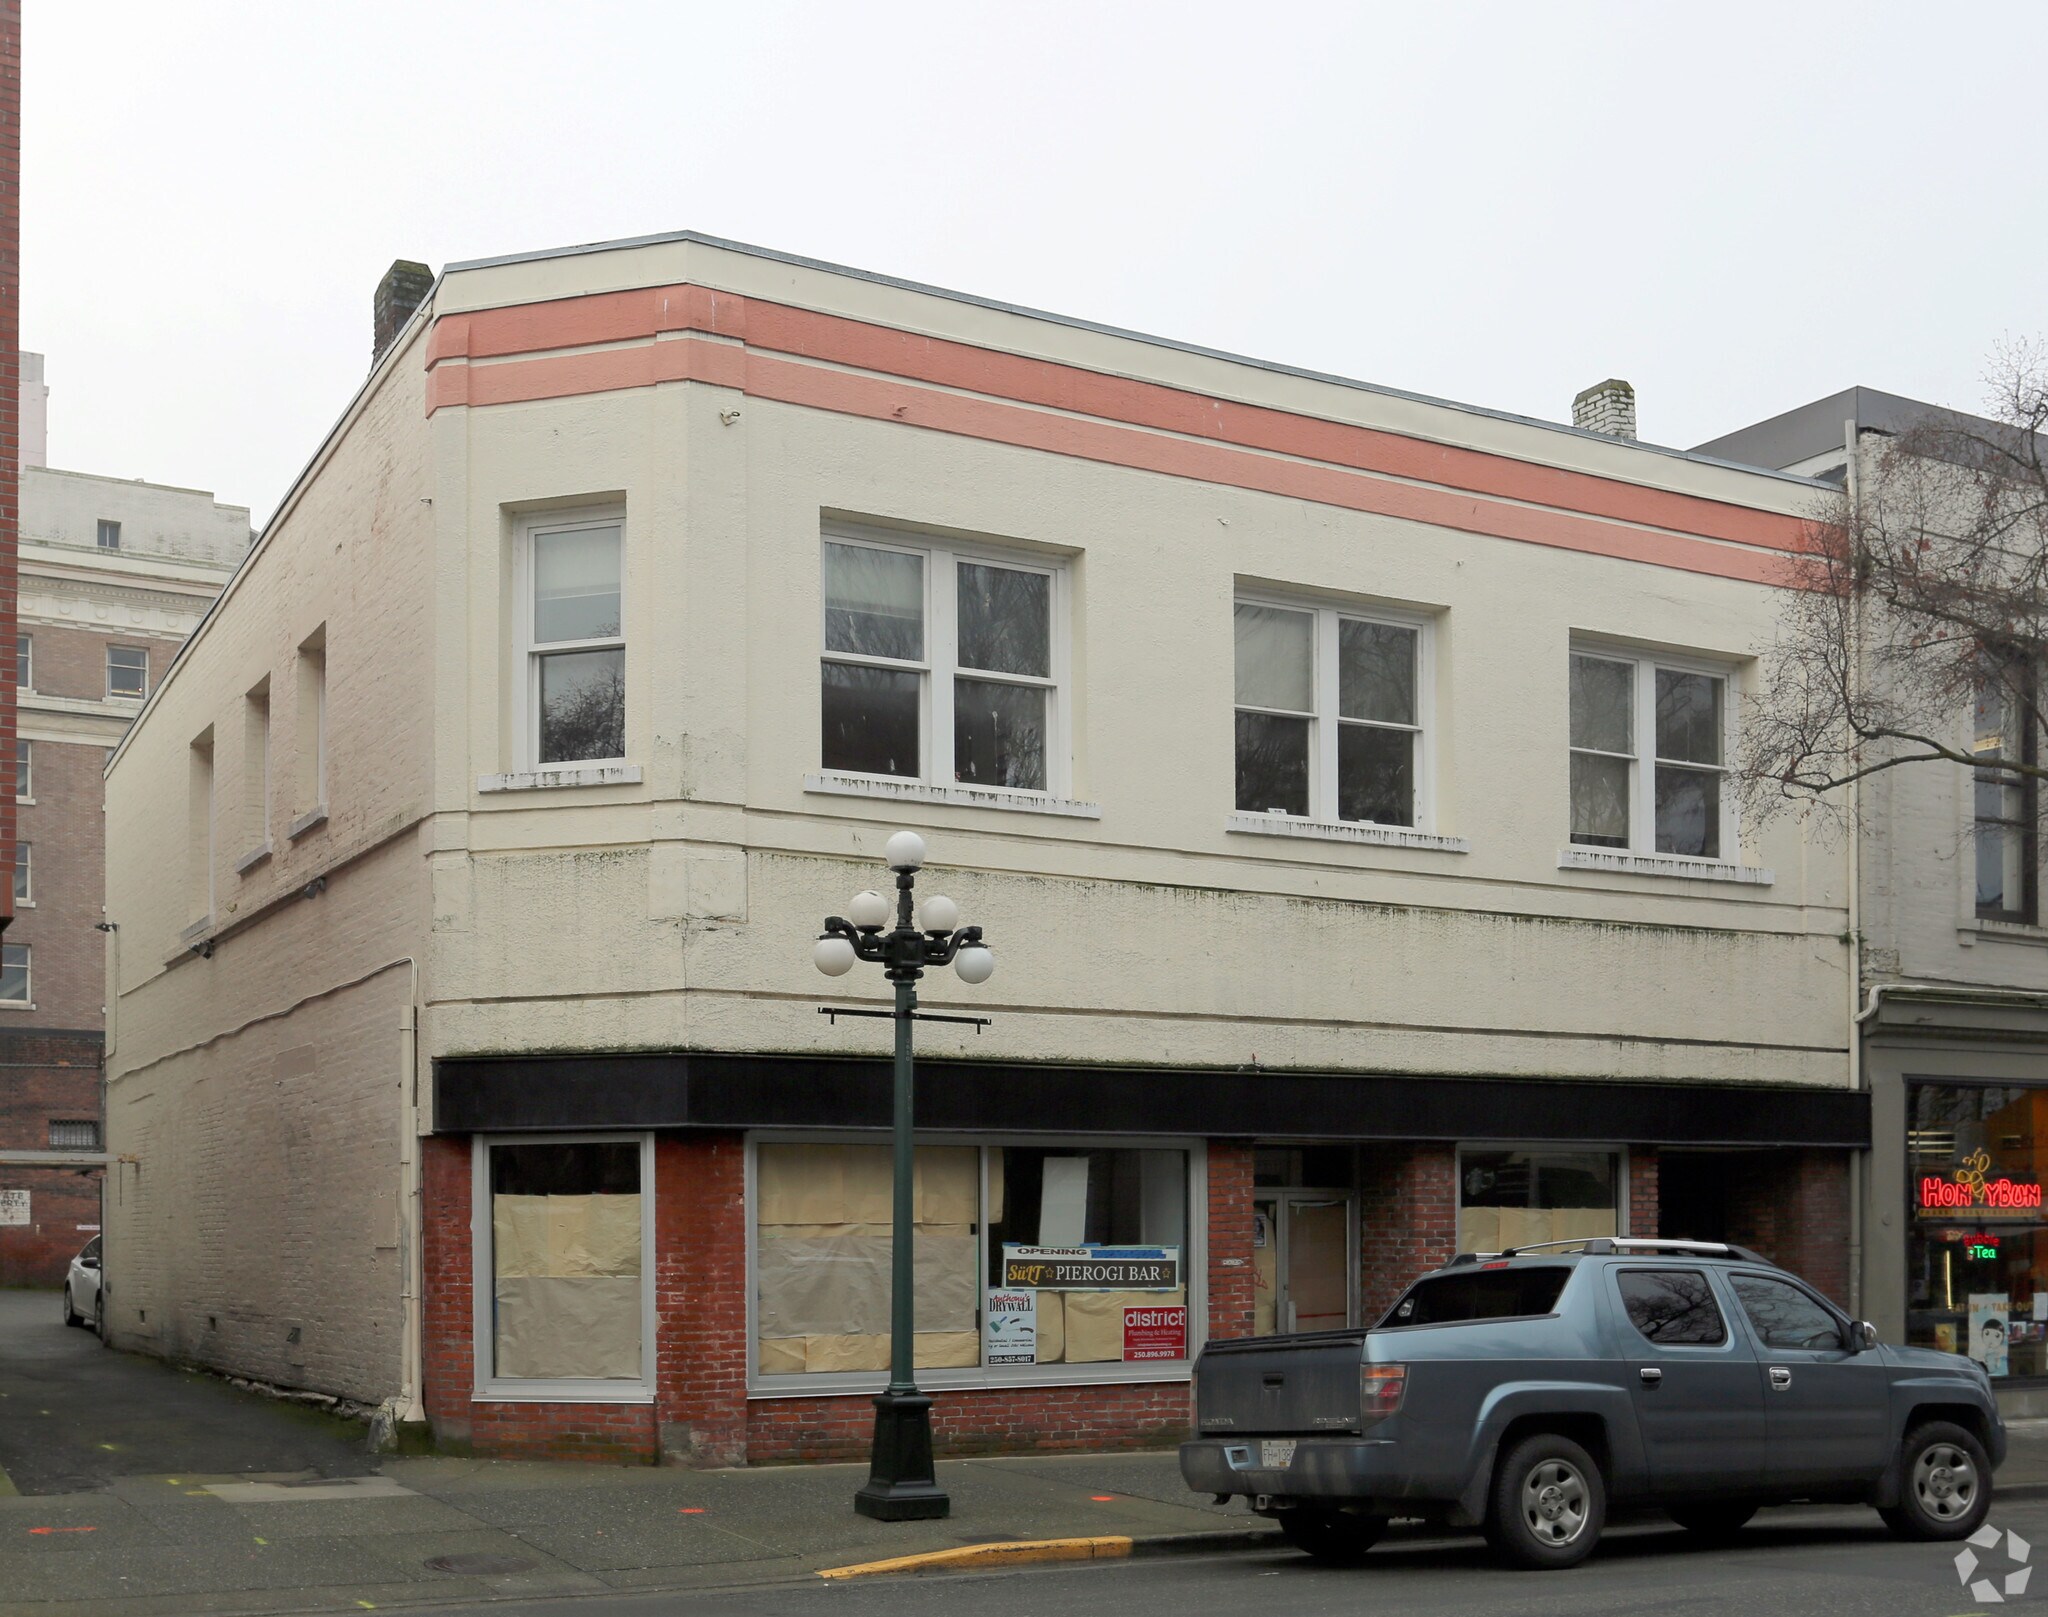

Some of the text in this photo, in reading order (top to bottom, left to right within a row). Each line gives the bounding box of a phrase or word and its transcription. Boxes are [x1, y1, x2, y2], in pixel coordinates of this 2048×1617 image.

[1017, 1248, 1087, 1256] OPENING
[1974, 1245, 1996, 1258] Tea
[1055, 1265, 1124, 1281] PIEROGI
[1128, 1266, 1161, 1281] BAR
[989, 1297, 1033, 1312] DRYWALL
[1125, 1310, 1185, 1327] district
[1134, 1350, 1175, 1358] 250.896.9978
